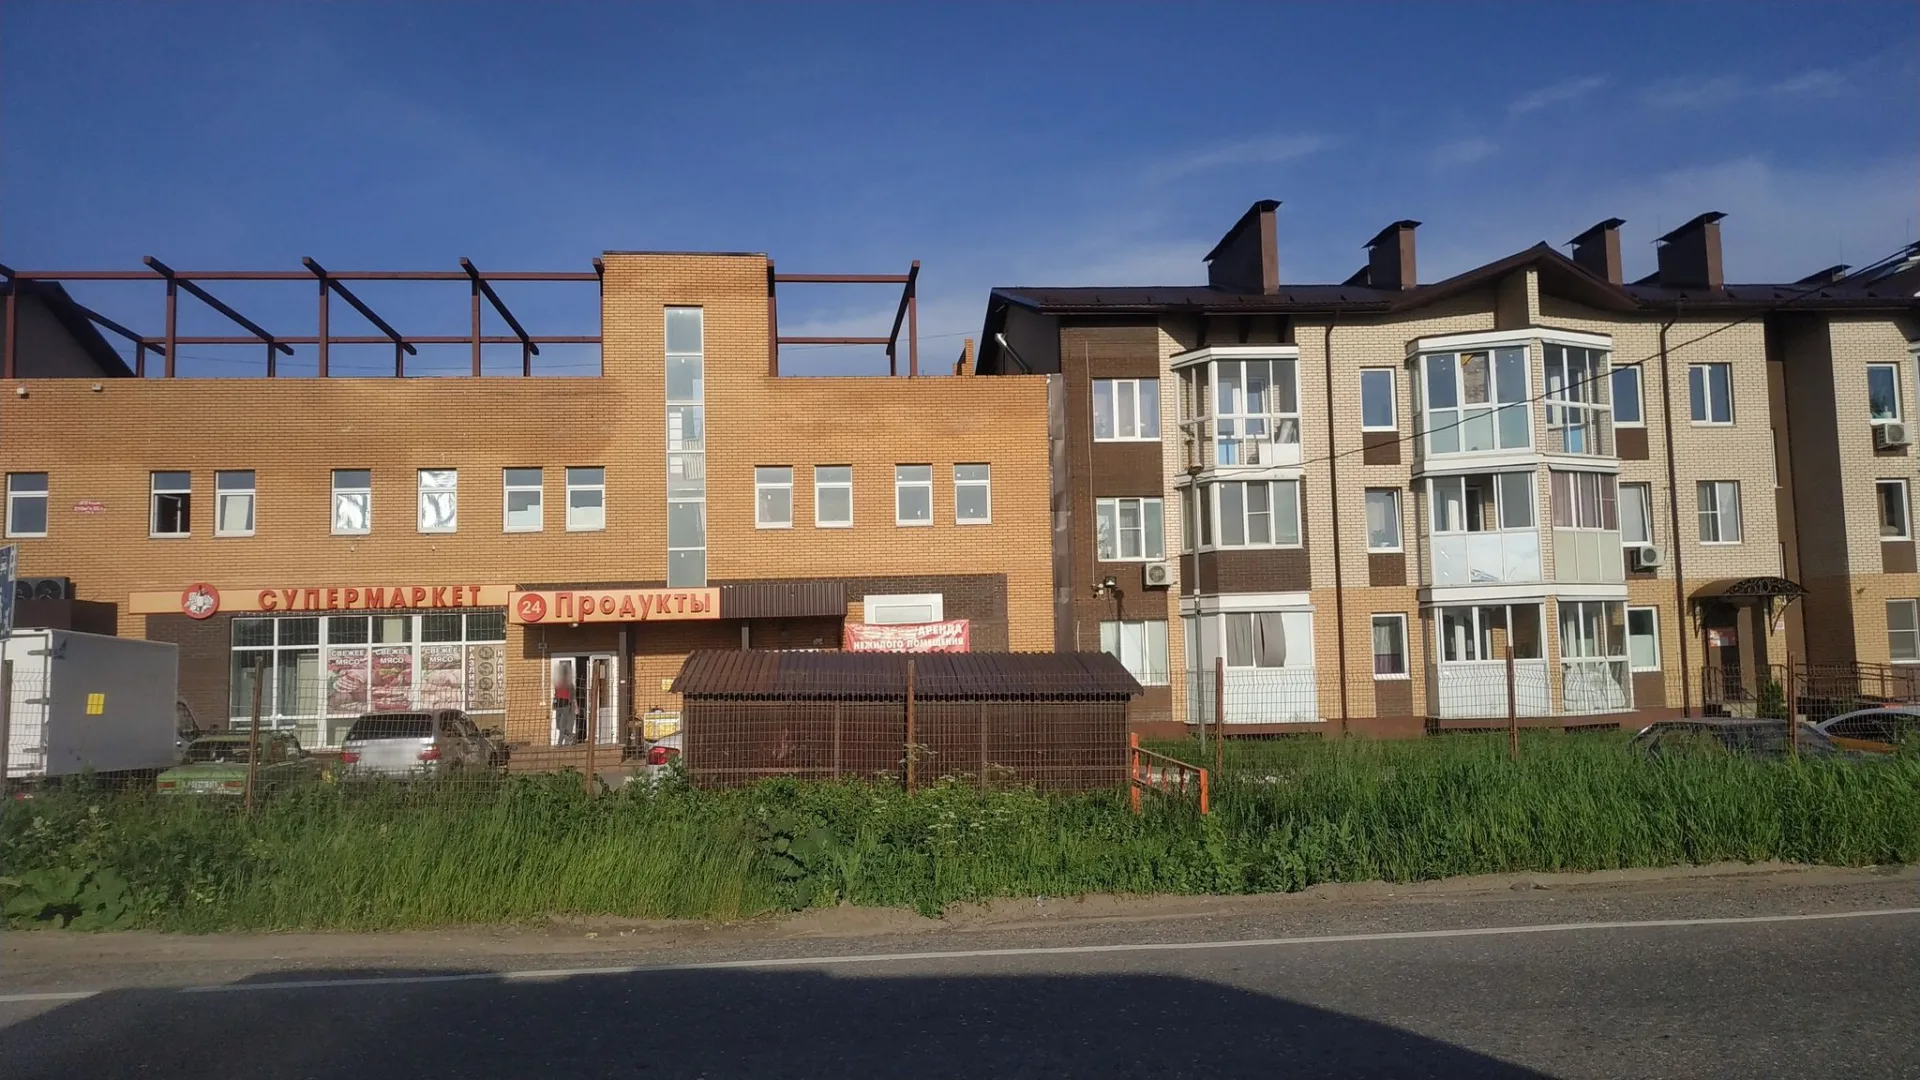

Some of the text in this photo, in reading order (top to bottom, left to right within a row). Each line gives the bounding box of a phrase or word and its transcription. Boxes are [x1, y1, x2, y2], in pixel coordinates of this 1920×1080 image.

[258, 586, 481, 611] СУПЕРМАРКЕТ
[521, 592, 710, 622] 24 Продукты
[917, 624, 963, 635] АРЕНДА
[853, 637, 964, 650] НЕЖИЛОГО ПОМЕЩЕНИЯ
[331, 649, 365, 657] СВЕЖЕЕ
[375, 648, 410, 656] СВЕЖЕЕ
[468, 646, 476, 708] РАЗЛИВНЫЕ
